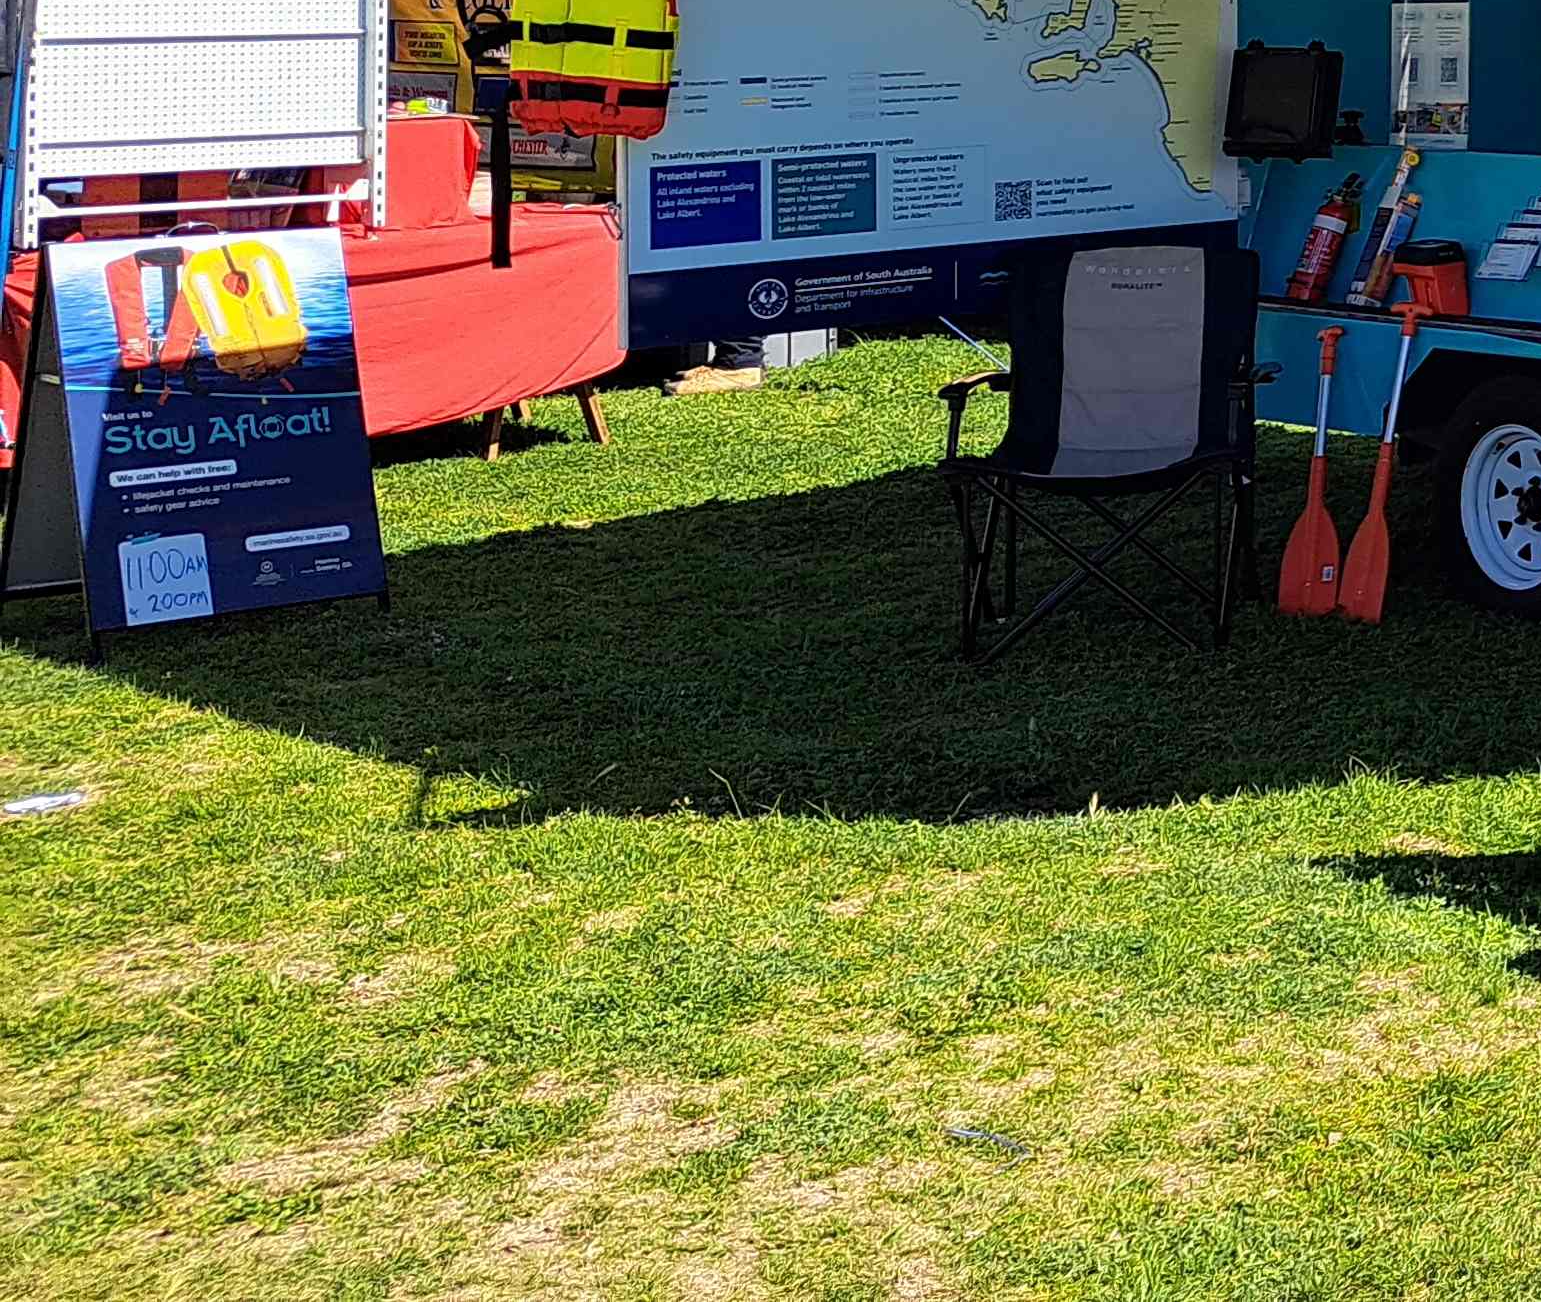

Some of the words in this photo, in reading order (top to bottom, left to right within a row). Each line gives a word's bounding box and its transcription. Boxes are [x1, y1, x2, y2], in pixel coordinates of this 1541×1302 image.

[102, 411, 125, 422] Visit
[127, 411, 140, 421] us
[142, 410, 153, 420] to
[105, 424, 196, 455] Stay
[208, 406, 331, 448] Afloat!
[116, 473, 134, 484] We
[136, 472, 156, 482] can
[158, 467, 181, 481] help
[183, 465, 205, 477] with
[177, 485, 210, 497] checks
[212, 481, 230, 493] and
[232, 476, 291, 491] maintenance
[134, 503, 163, 515] safety
[165, 500, 187, 513] gear
[190, 496, 220, 508] advice
